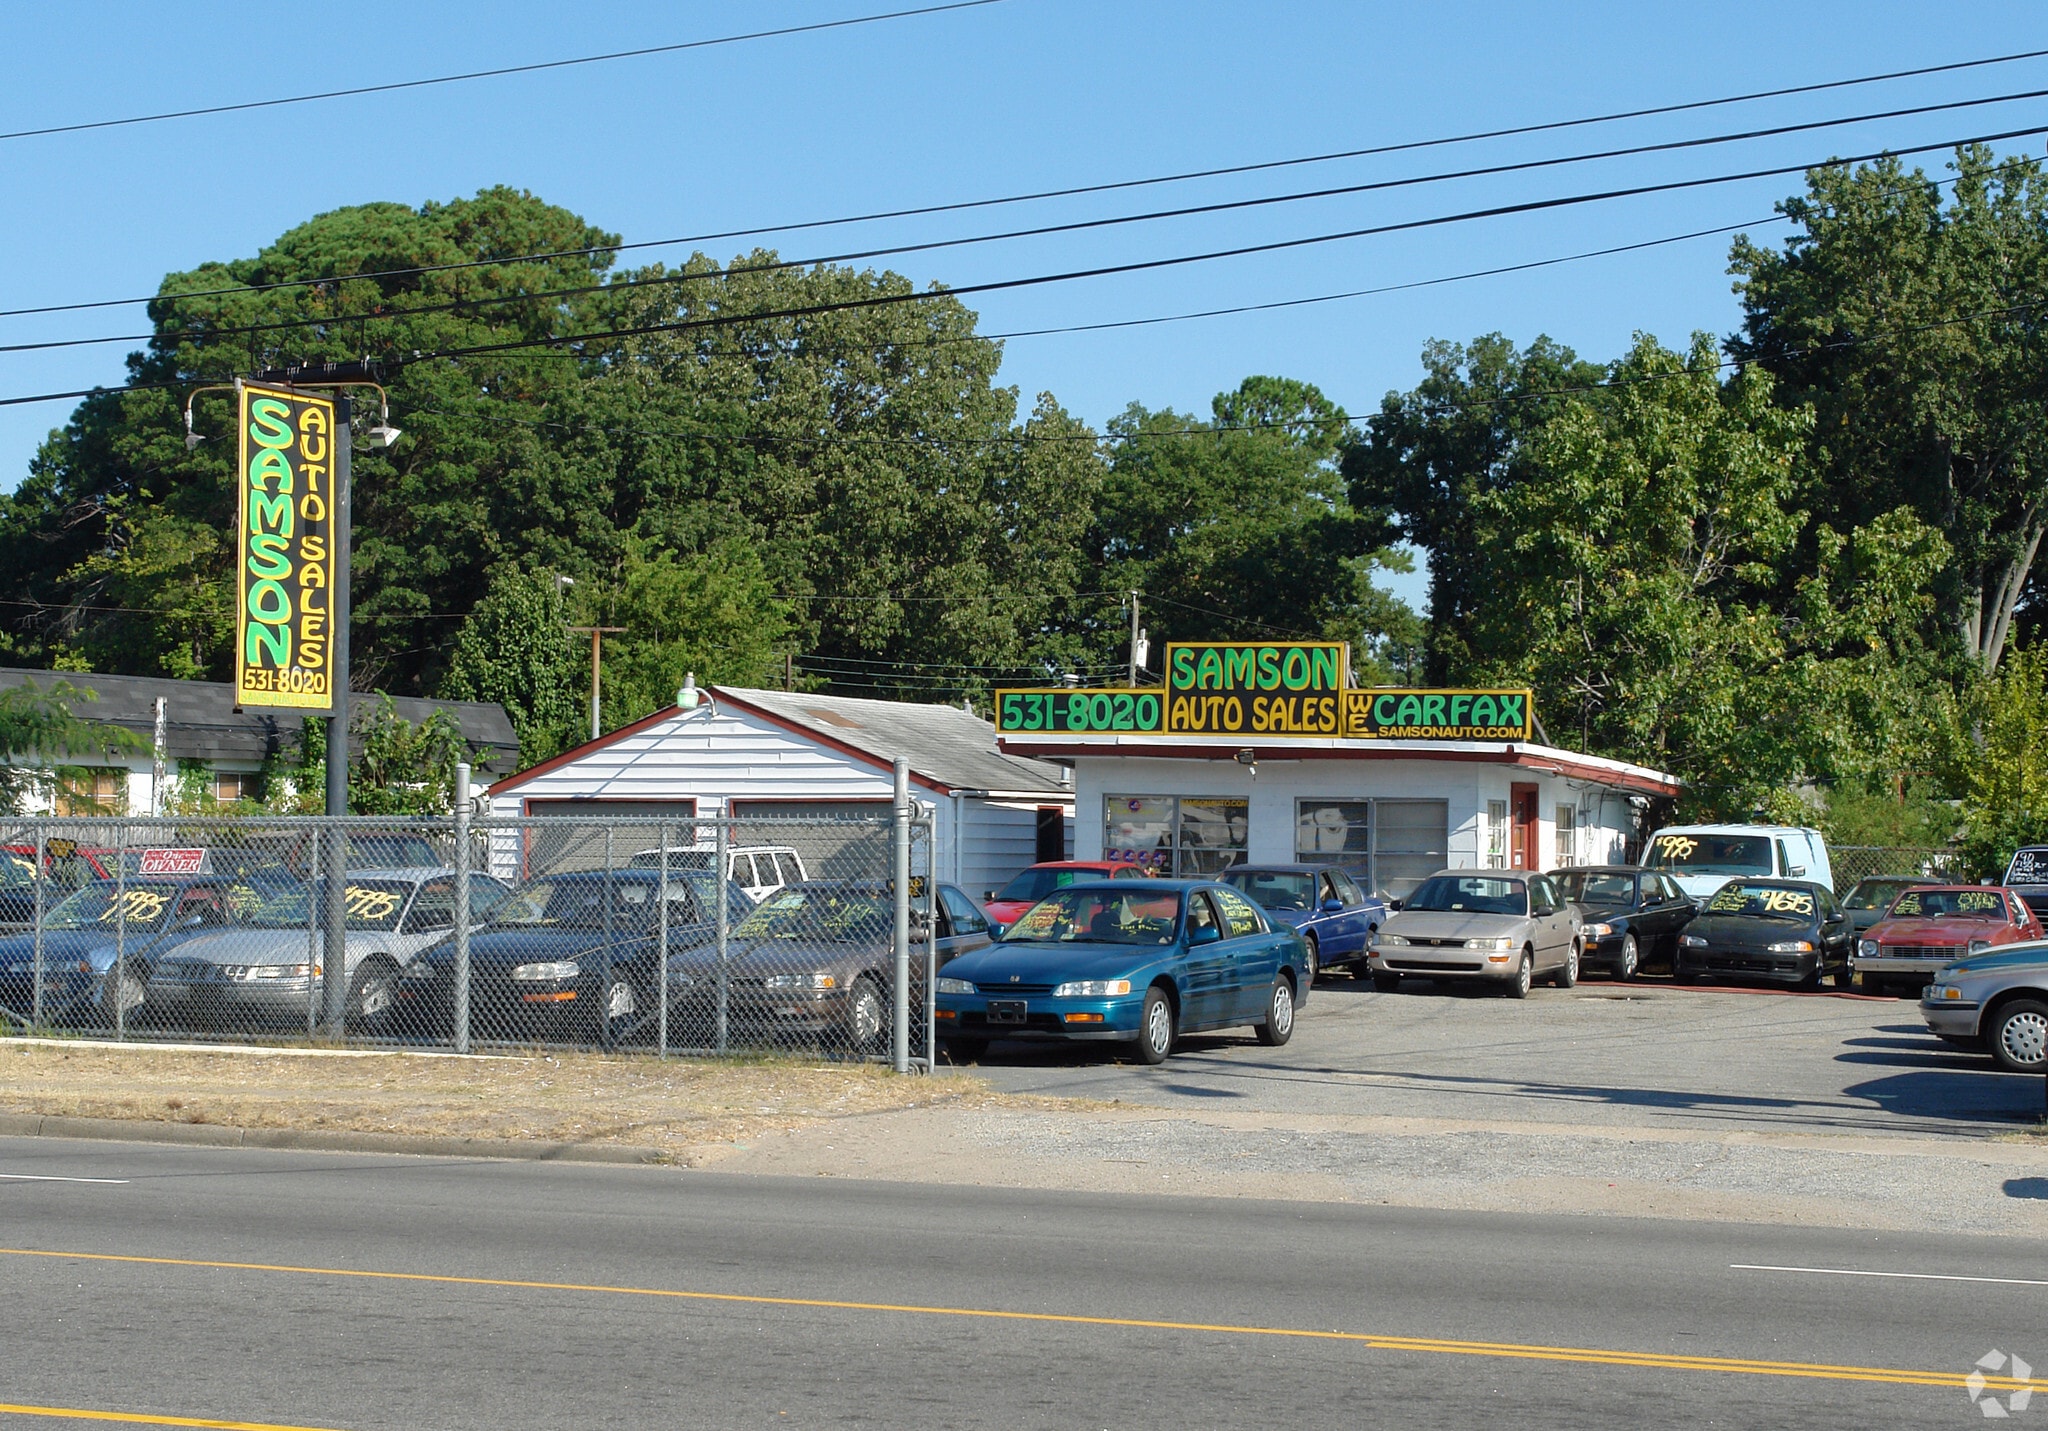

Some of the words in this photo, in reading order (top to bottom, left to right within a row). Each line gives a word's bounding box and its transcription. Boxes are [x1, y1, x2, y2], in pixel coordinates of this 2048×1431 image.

[298, 407, 327, 522] AUTO
[246, 398, 294, 669] SAMSON
[298, 535, 326, 669] SALES
[244, 668, 326, 694] 531-8020
[1172, 647, 1338, 691] SAMSON
[1002, 693, 1159, 731] 531-8020
[1171, 696, 1243, 731] AUTO
[1251, 696, 1336, 732] SALES
[1373, 695, 1523, 726] CARFAX
[1378, 726, 1522, 738] SAMSONAUTO.COM
[142, 859, 199, 871] OWNER
